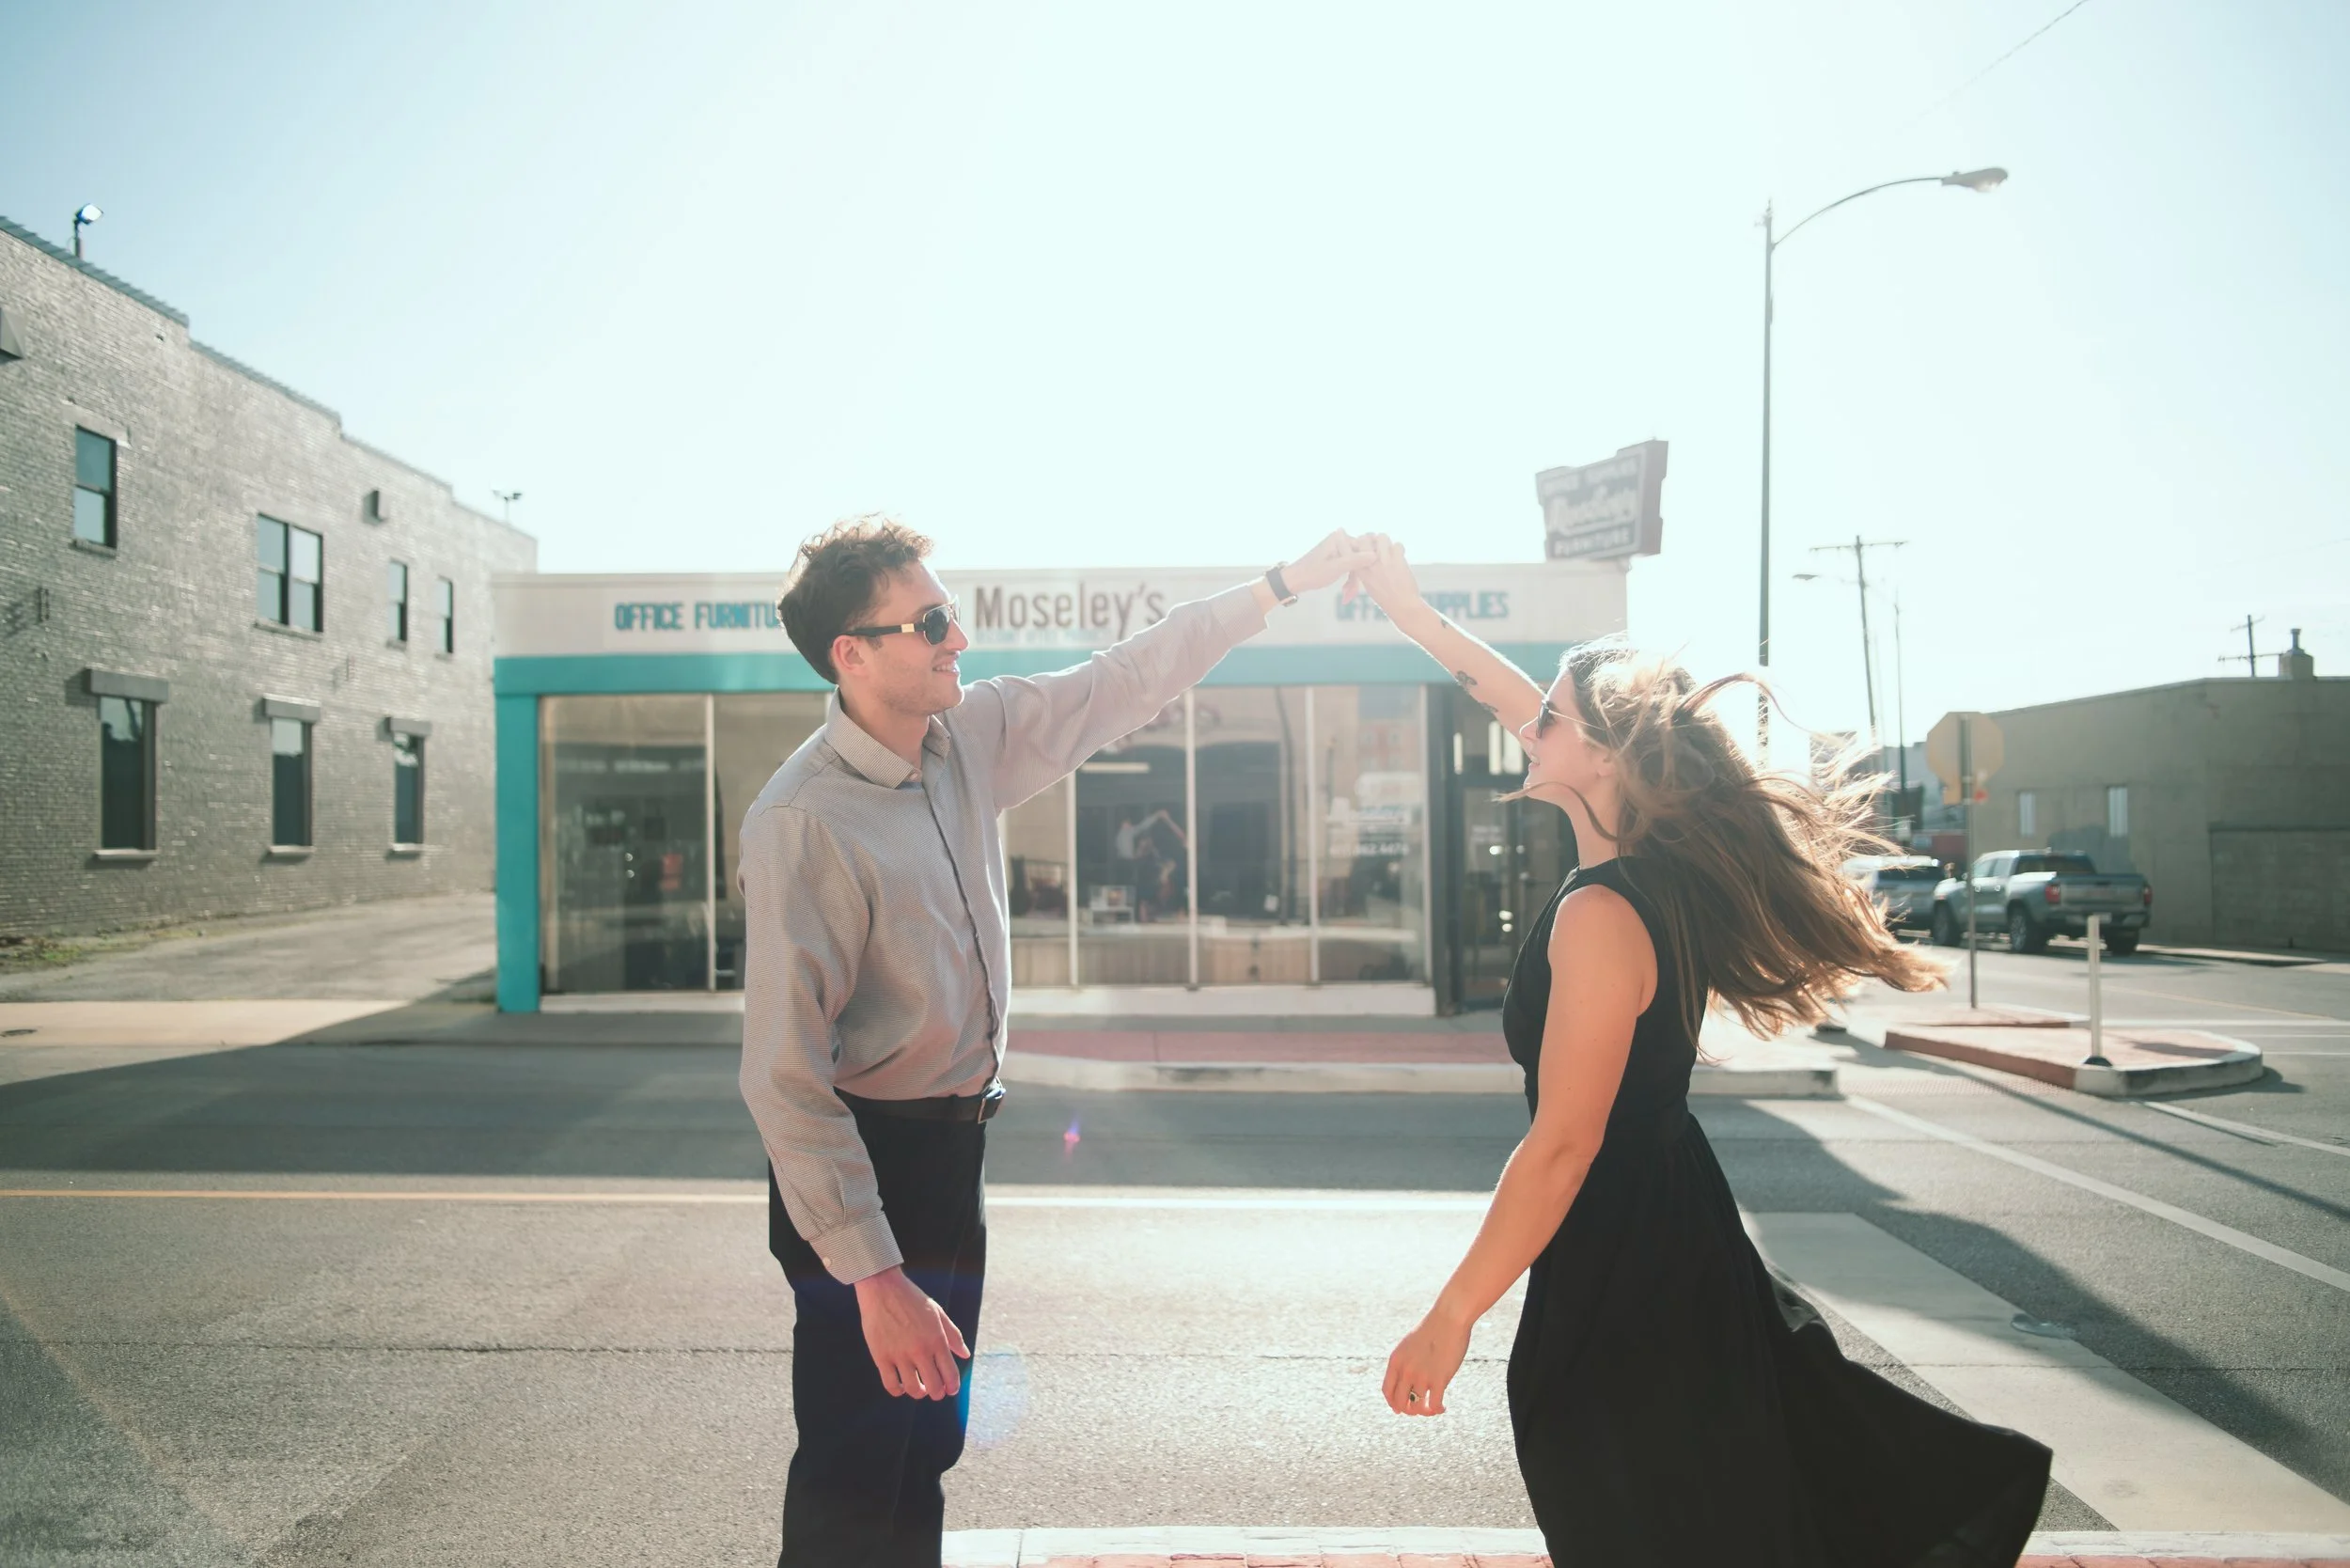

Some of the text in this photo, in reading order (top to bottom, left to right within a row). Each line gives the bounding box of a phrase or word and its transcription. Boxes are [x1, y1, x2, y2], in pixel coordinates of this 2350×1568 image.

[615, 602, 779, 631] OFFICE FURNITU
[976, 580, 1165, 641] Moseley's
